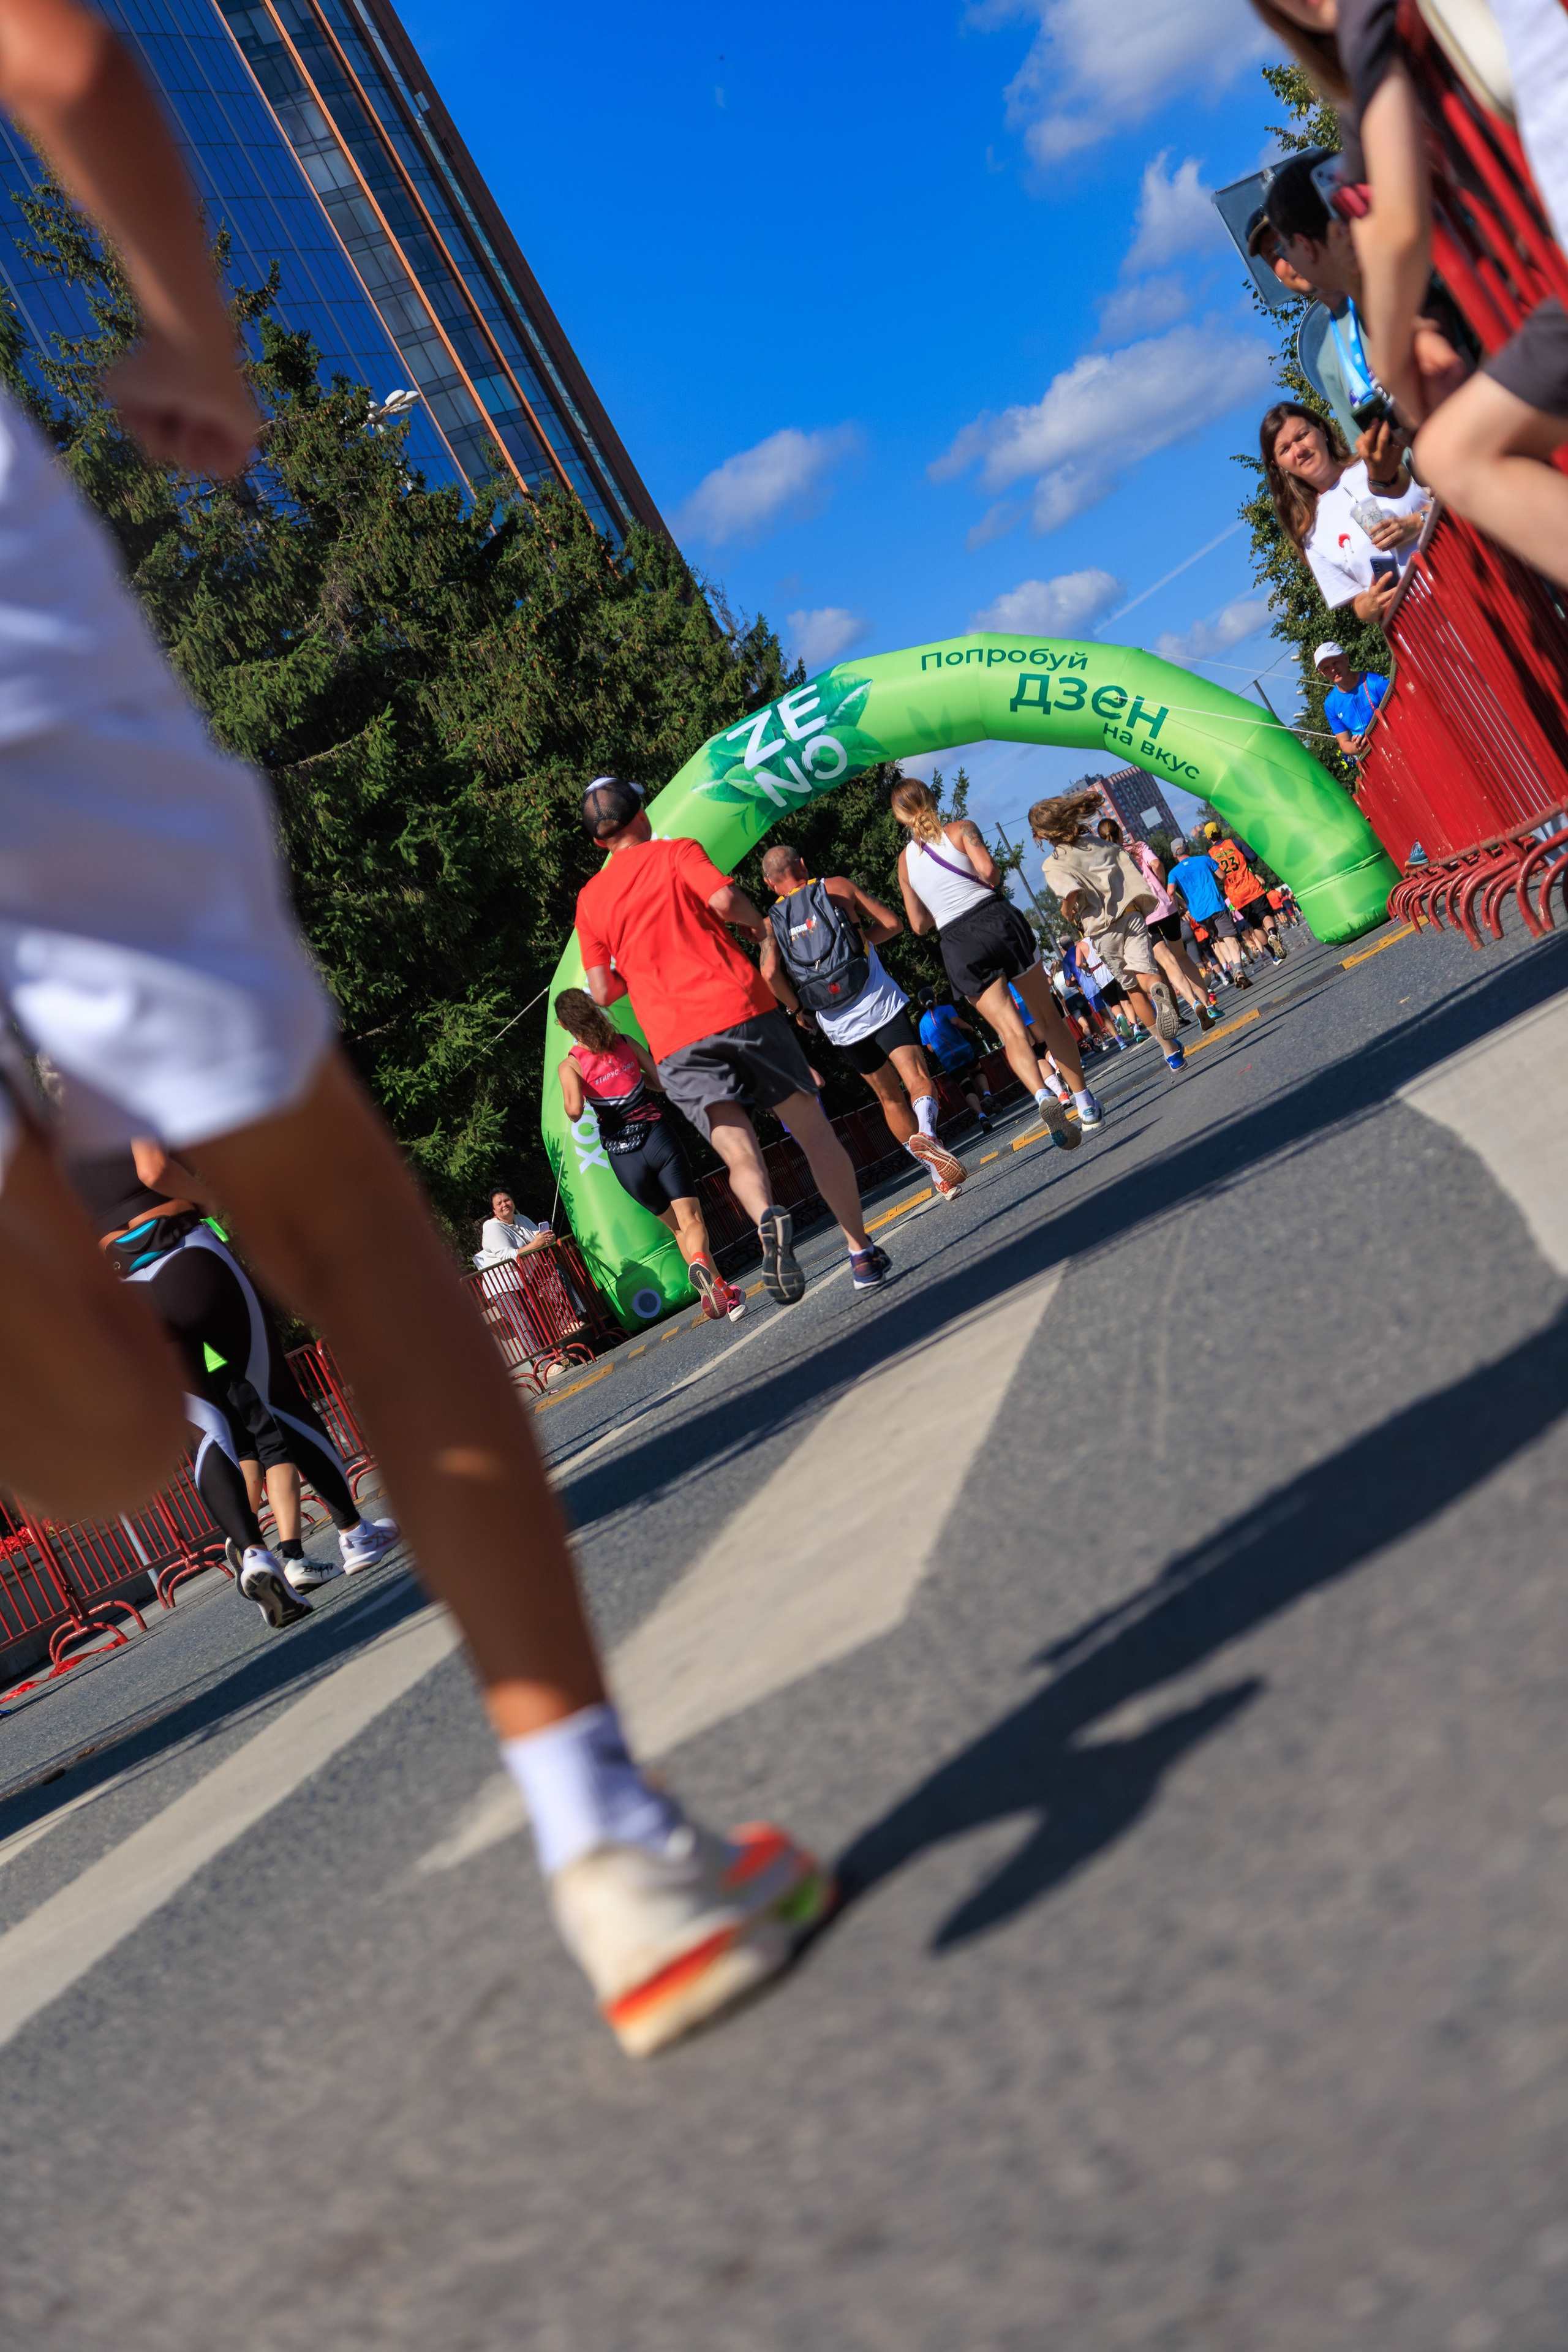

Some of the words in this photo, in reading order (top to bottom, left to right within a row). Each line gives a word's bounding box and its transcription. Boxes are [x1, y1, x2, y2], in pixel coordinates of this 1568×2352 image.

[921, 648, 1088, 671] Попробуй
[1102, 722, 1133, 747] на
[1139, 740, 1200, 780] вкус
[1219, 856, 1240, 875] 23
